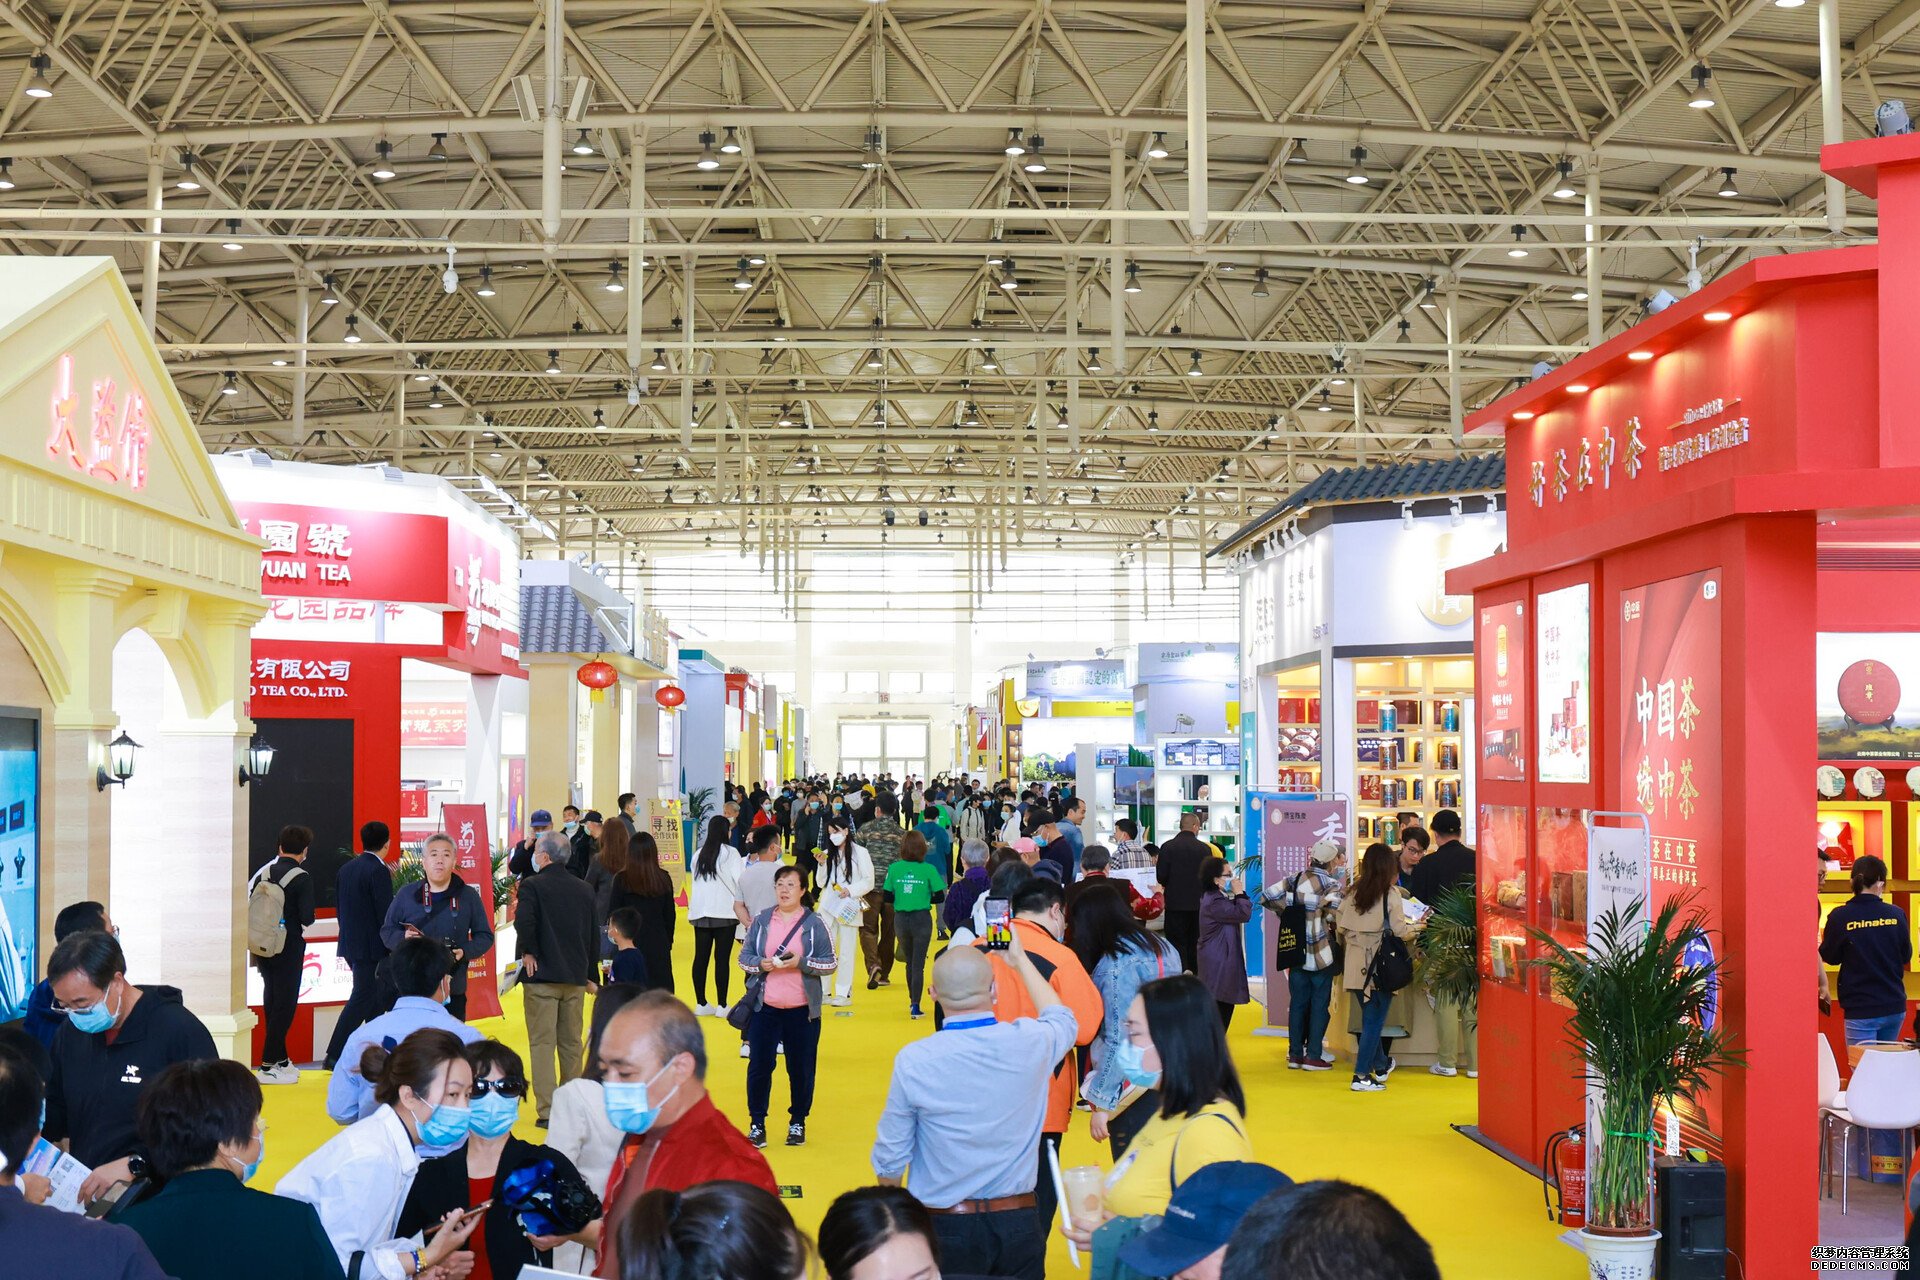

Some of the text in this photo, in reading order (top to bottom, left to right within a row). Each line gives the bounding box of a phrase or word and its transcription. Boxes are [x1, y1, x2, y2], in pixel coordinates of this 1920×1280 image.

[317, 563, 352, 581] TEA
[250, 657, 351, 682] 有限公司
[260, 685, 287, 696] TEA
[1636, 676, 1701, 747] 中国茶
[1636, 755, 1701, 821] 选中茶
[653, 818, 679, 832] 寻找
[1643, 838, 1696, 864] 茶在中茶
[1648, 865, 1698, 888] 国真正的普洱茶
[1846, 918, 1898, 931] Chinatea
